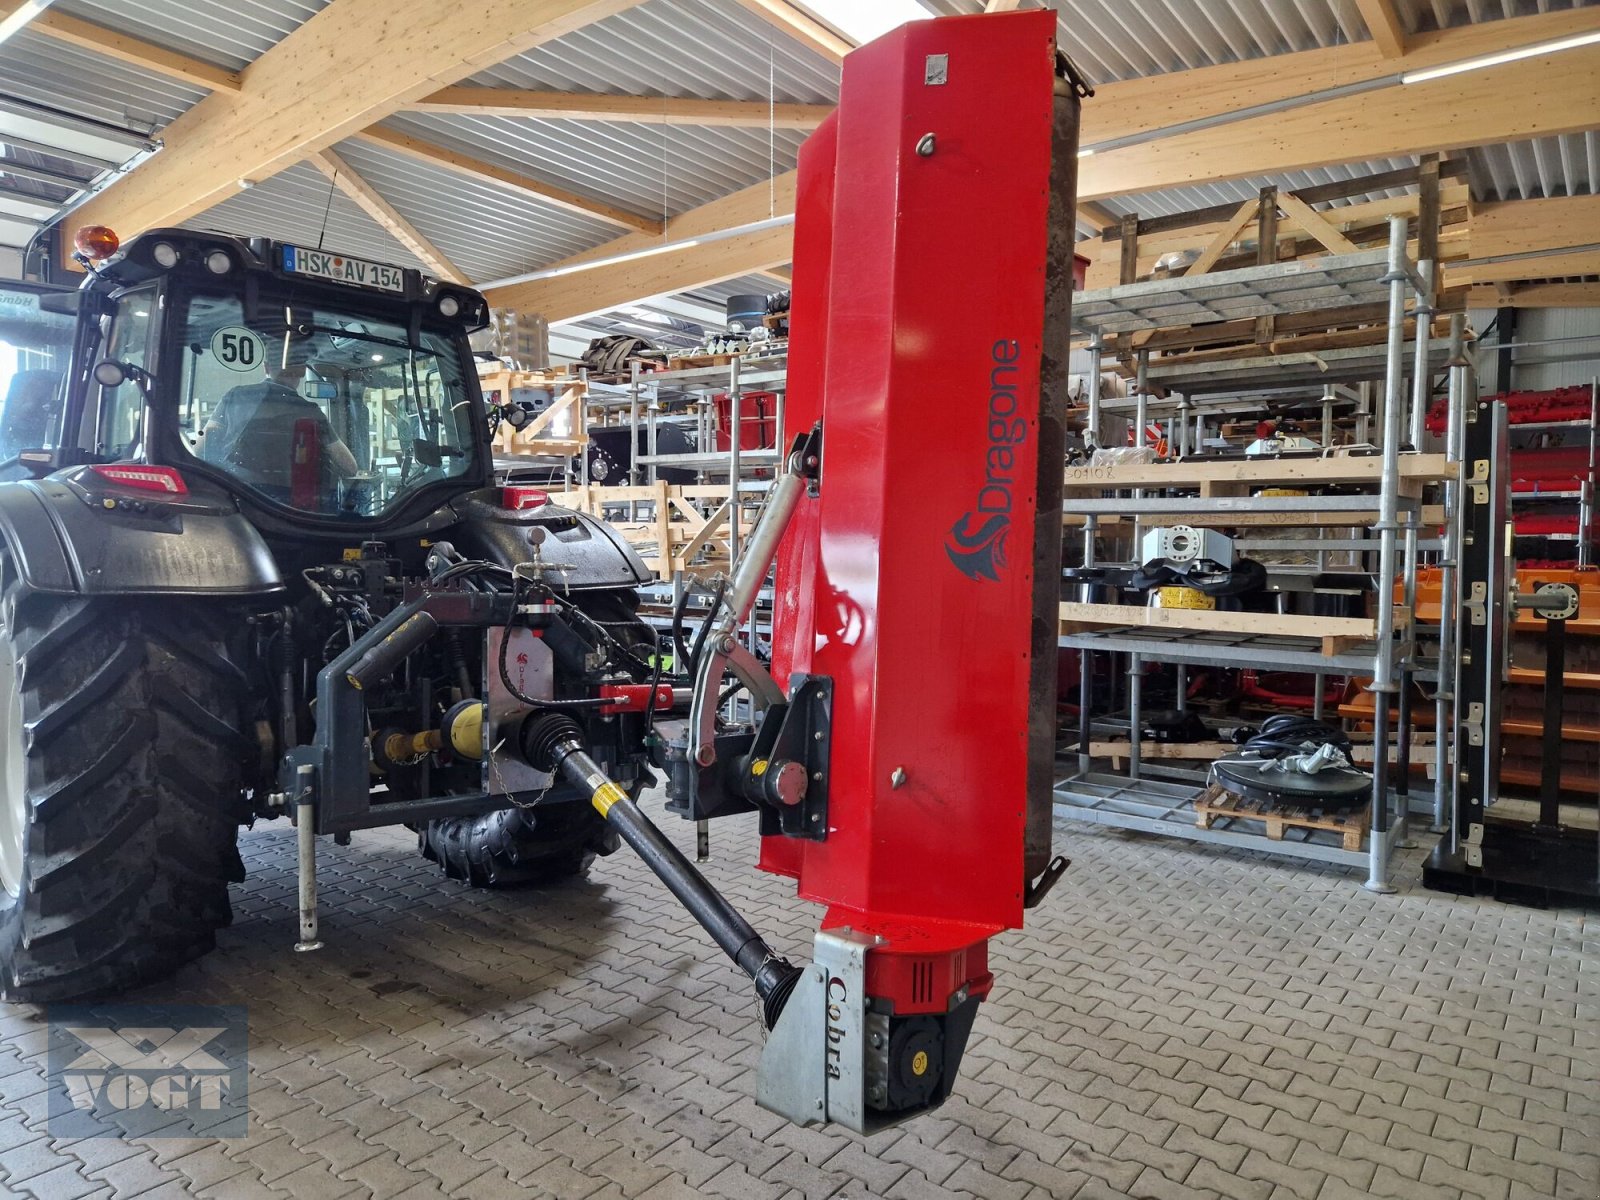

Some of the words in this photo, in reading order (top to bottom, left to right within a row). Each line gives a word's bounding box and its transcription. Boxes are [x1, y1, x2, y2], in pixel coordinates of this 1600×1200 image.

[296, 250, 332, 276] HSK
[344, 260, 366, 282] AV
[370, 266, 401, 289] 154
[222, 333, 254, 365] 50
[977, 338, 1027, 514] Dragone
[828, 976, 847, 1081] Cobra
